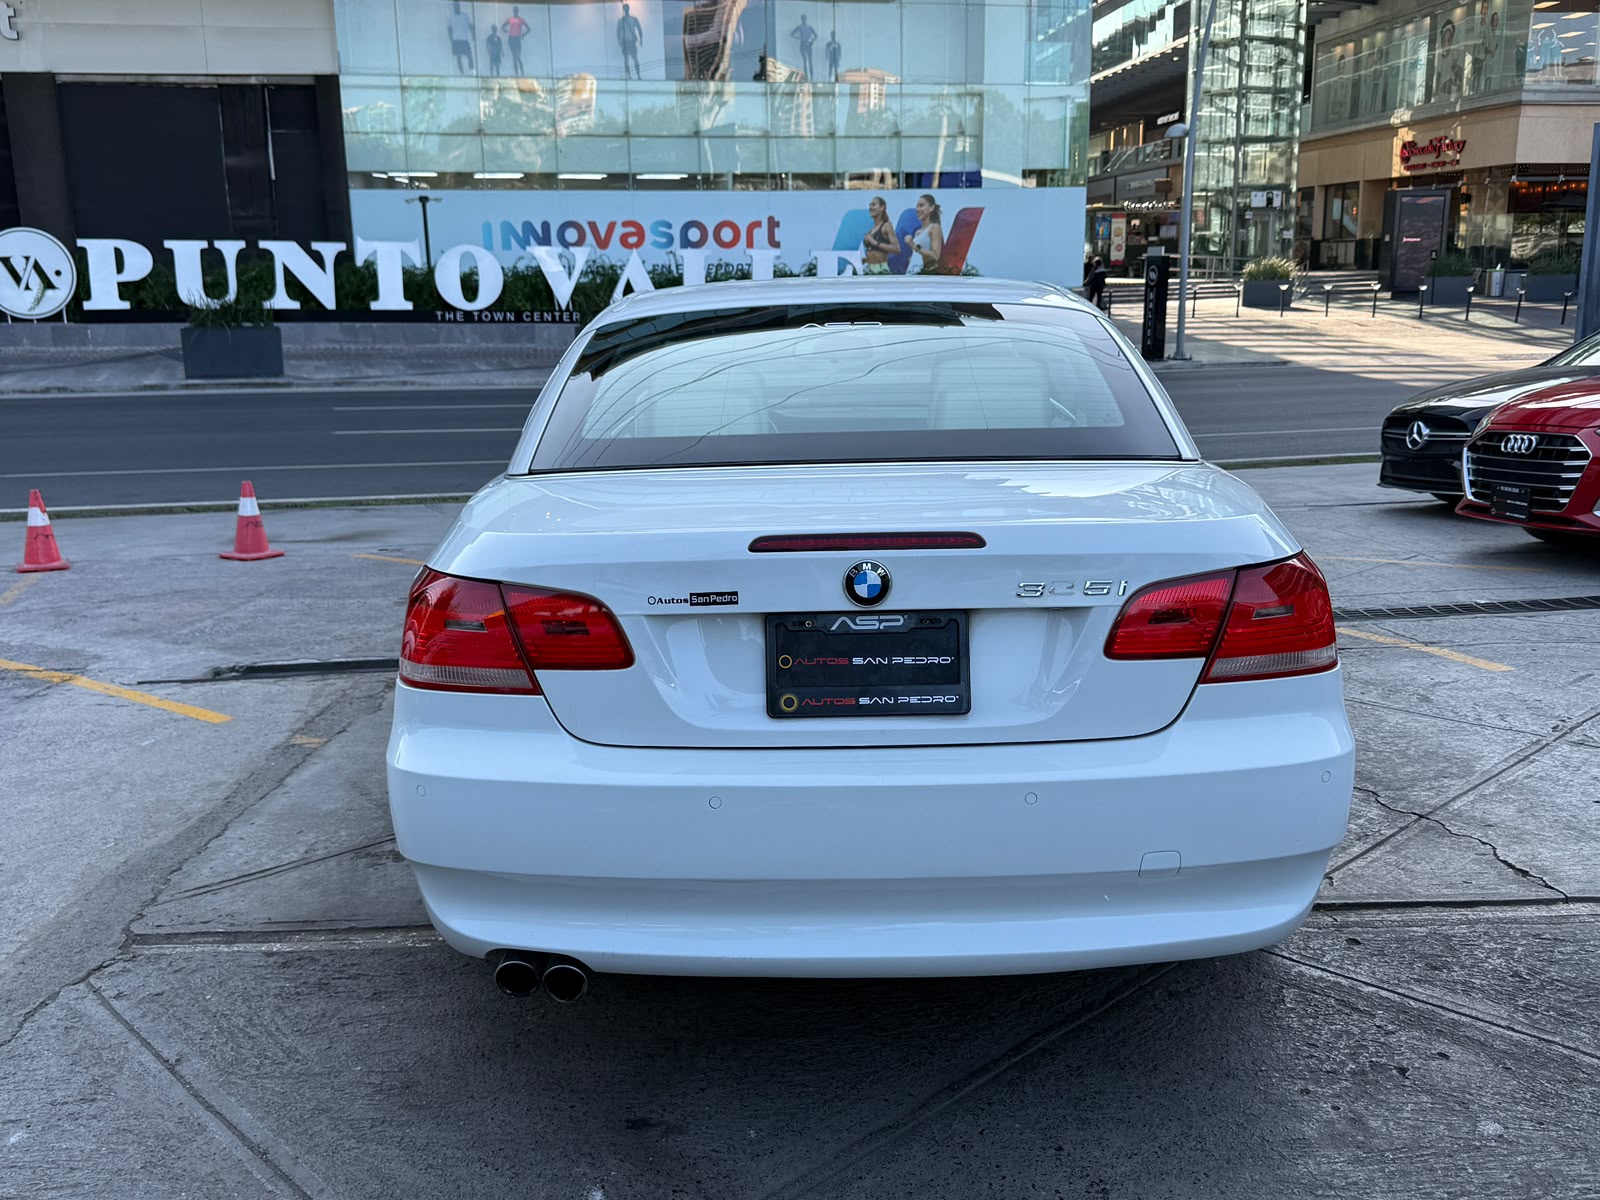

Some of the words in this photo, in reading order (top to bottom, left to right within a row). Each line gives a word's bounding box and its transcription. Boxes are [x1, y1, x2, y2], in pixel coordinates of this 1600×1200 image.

[76, 237, 504, 311] PUNTO
[435, 311, 464, 322] THE
[472, 311, 515, 322] TOWN
[522, 311, 581, 322] CENTER
[848, 562, 887, 578] BMW
[1016, 580, 1128, 597] 325i
[656, 596, 689, 605] Autos
[830, 614, 904, 631] ASP
[794, 657, 849, 665] AUTOS
[852, 656, 888, 665] SAN
[891, 656, 951, 665] PEDRO
[801, 697, 856, 706] AUTOS
[858, 696, 894, 705] SAN
[897, 695, 955, 704] PEDRO
